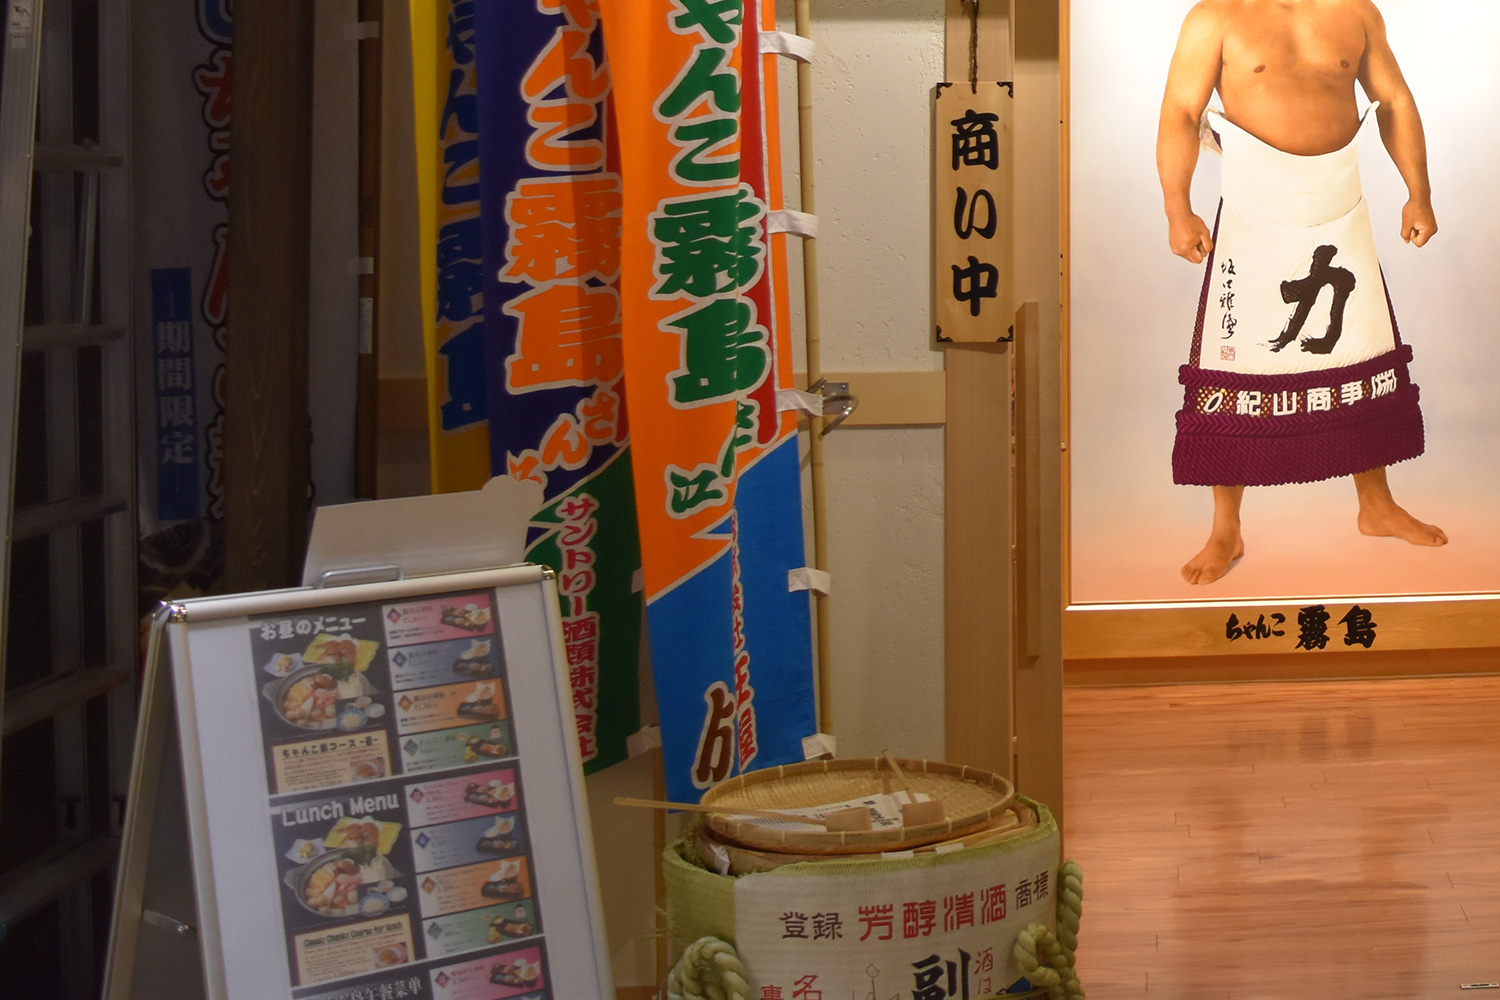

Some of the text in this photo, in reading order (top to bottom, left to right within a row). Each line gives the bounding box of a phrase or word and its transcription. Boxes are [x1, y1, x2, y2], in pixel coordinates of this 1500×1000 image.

[951, 109, 999, 317] 商い中
[1267, 244, 1357, 355] 力
[156, 319, 196, 466] 期間限定
[260, 615, 367, 641] お昼のメニュー
[1226, 604, 1378, 651] ちゃんこ 霧島
[282, 800, 345, 827] Lunch
[350, 793, 400, 816] Menu
[857, 883, 1007, 942] 芳醇清酒
[1015, 870, 1049, 910] 商標
[779, 911, 844, 940] 登録
